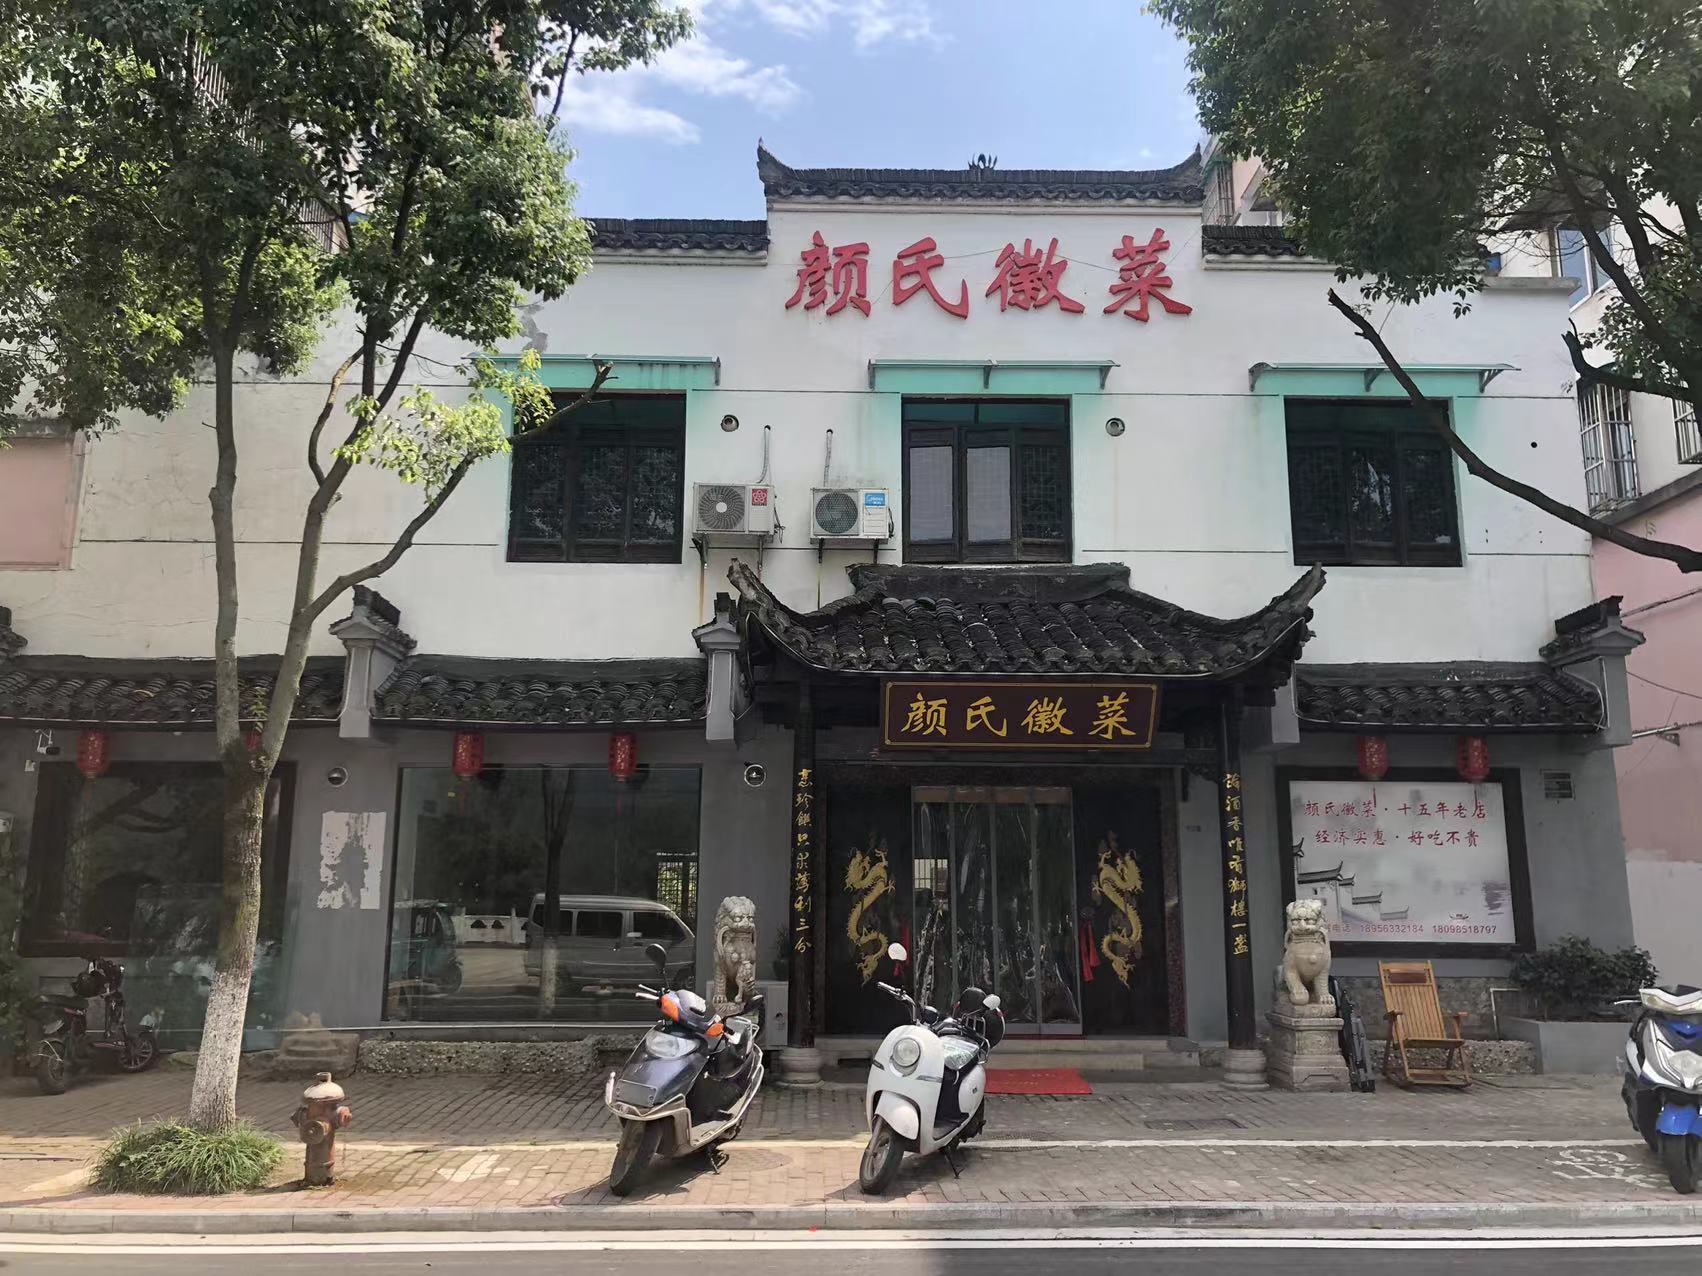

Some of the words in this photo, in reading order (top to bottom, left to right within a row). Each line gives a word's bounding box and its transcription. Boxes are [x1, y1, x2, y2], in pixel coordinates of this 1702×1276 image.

[785, 227, 1193, 322] 颜氏徽菜
[901, 692, 1137, 740] 颜氏徽菜
